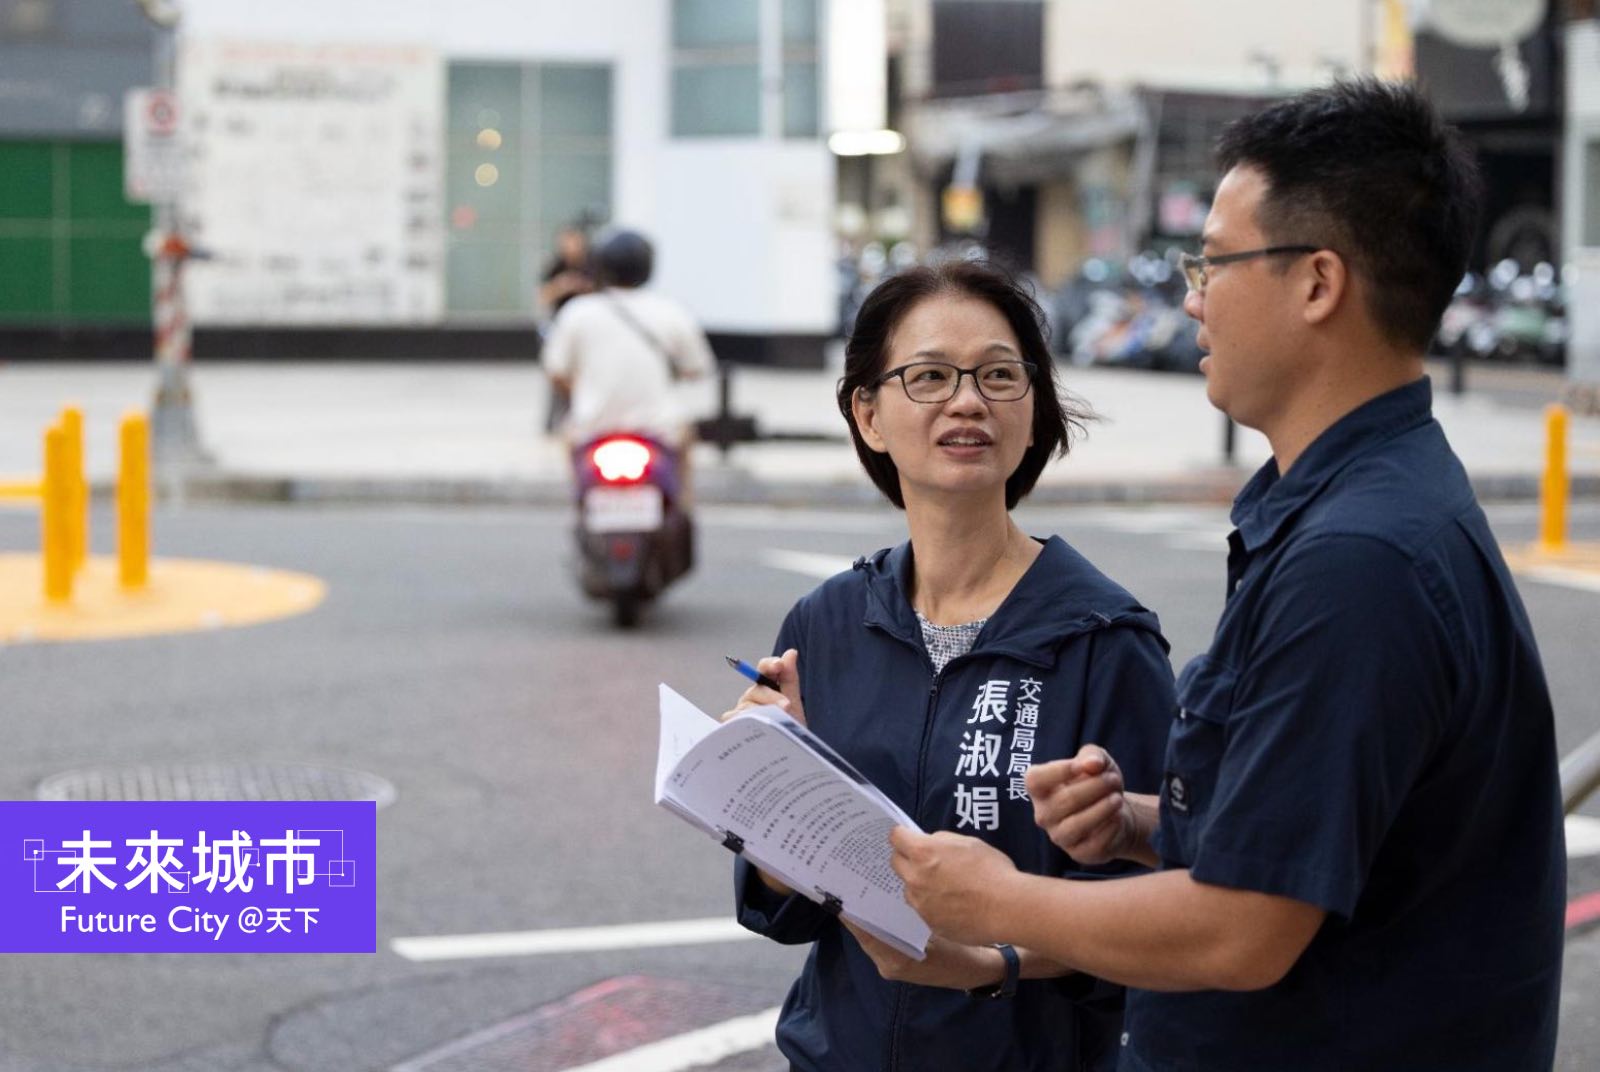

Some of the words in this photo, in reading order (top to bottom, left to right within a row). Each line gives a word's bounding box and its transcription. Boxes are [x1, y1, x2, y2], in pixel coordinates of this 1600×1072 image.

[954, 680, 1011, 830] 張淑娟
[1006, 677, 1043, 802] 交通局局長
